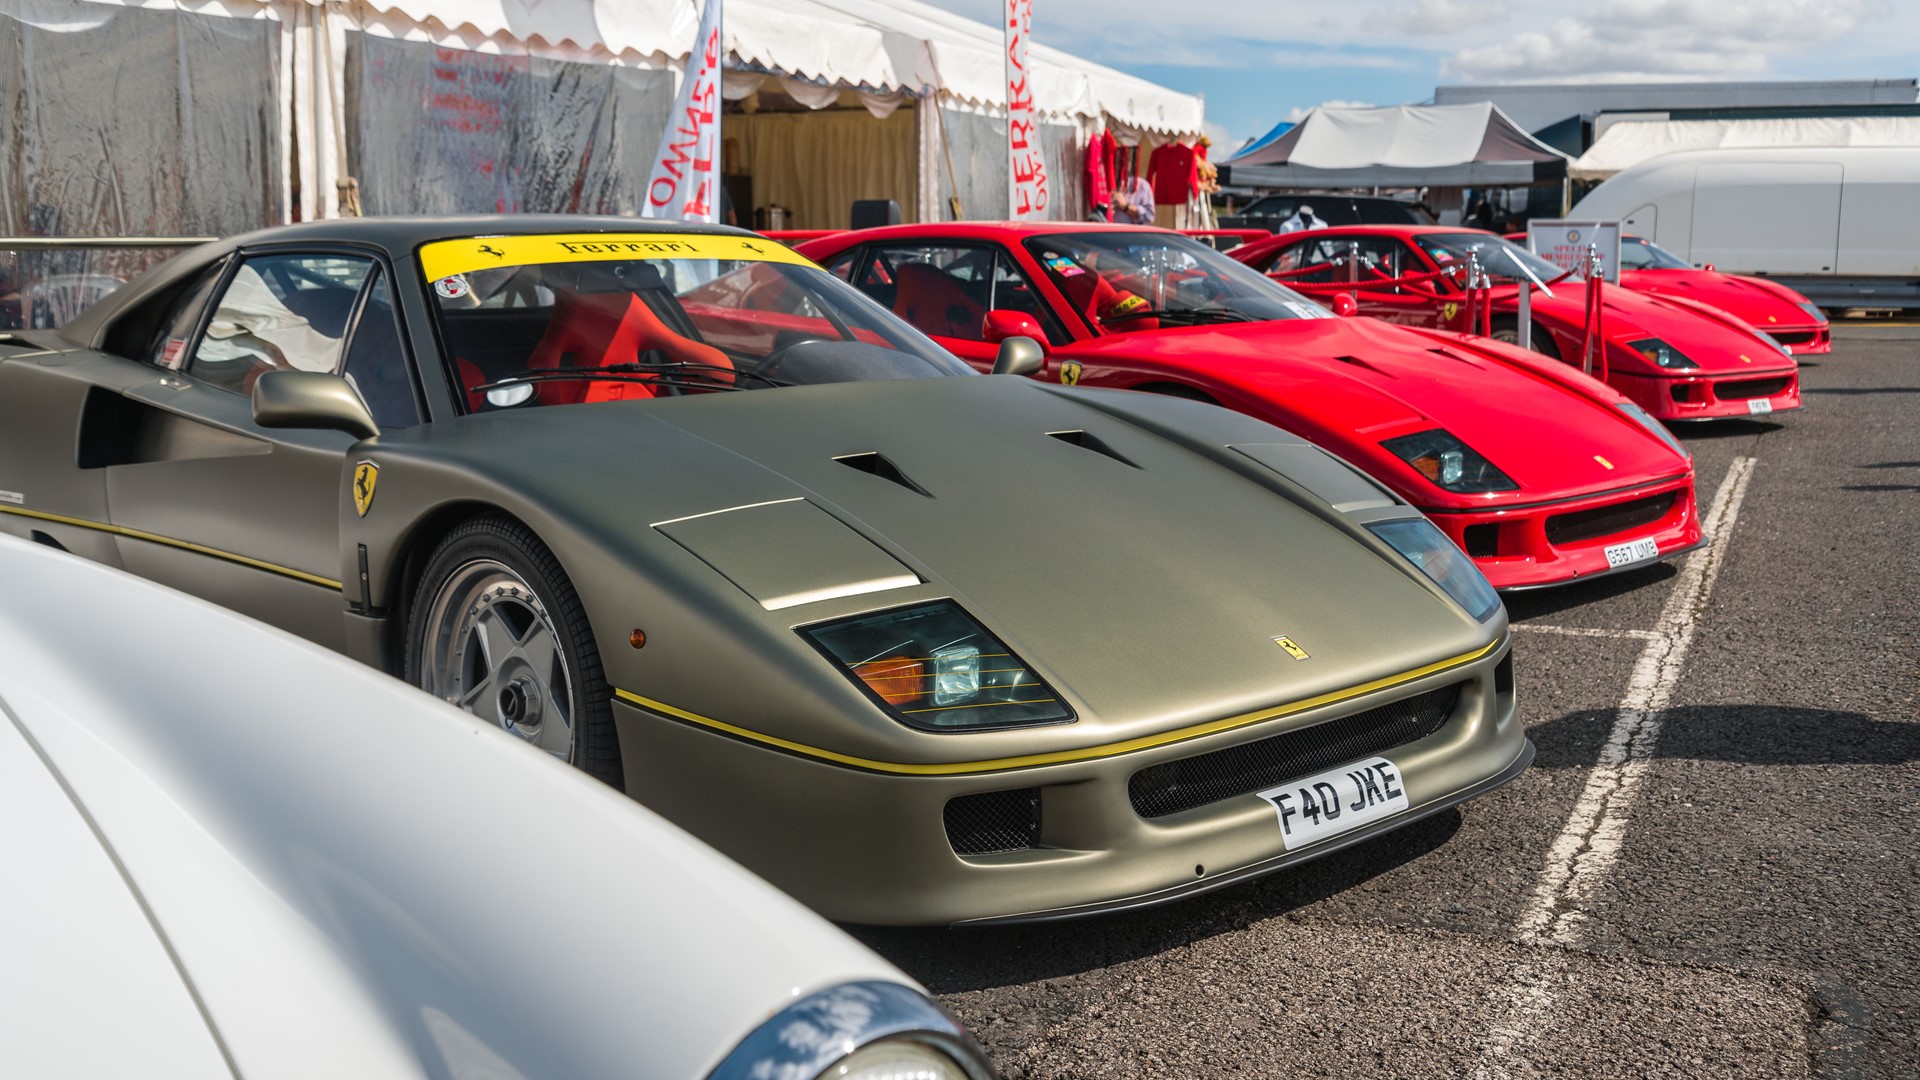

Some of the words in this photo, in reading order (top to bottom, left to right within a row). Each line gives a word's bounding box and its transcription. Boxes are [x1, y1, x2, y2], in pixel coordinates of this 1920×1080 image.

[1008, 0, 1035, 216] FERRAR
[556, 240, 701, 254] Ferrari
[1607, 546, 1634, 565] G567
[1634, 541, 1657, 558] UMB
[1270, 781, 1341, 835] F40
[1346, 761, 1403, 812] JKE
